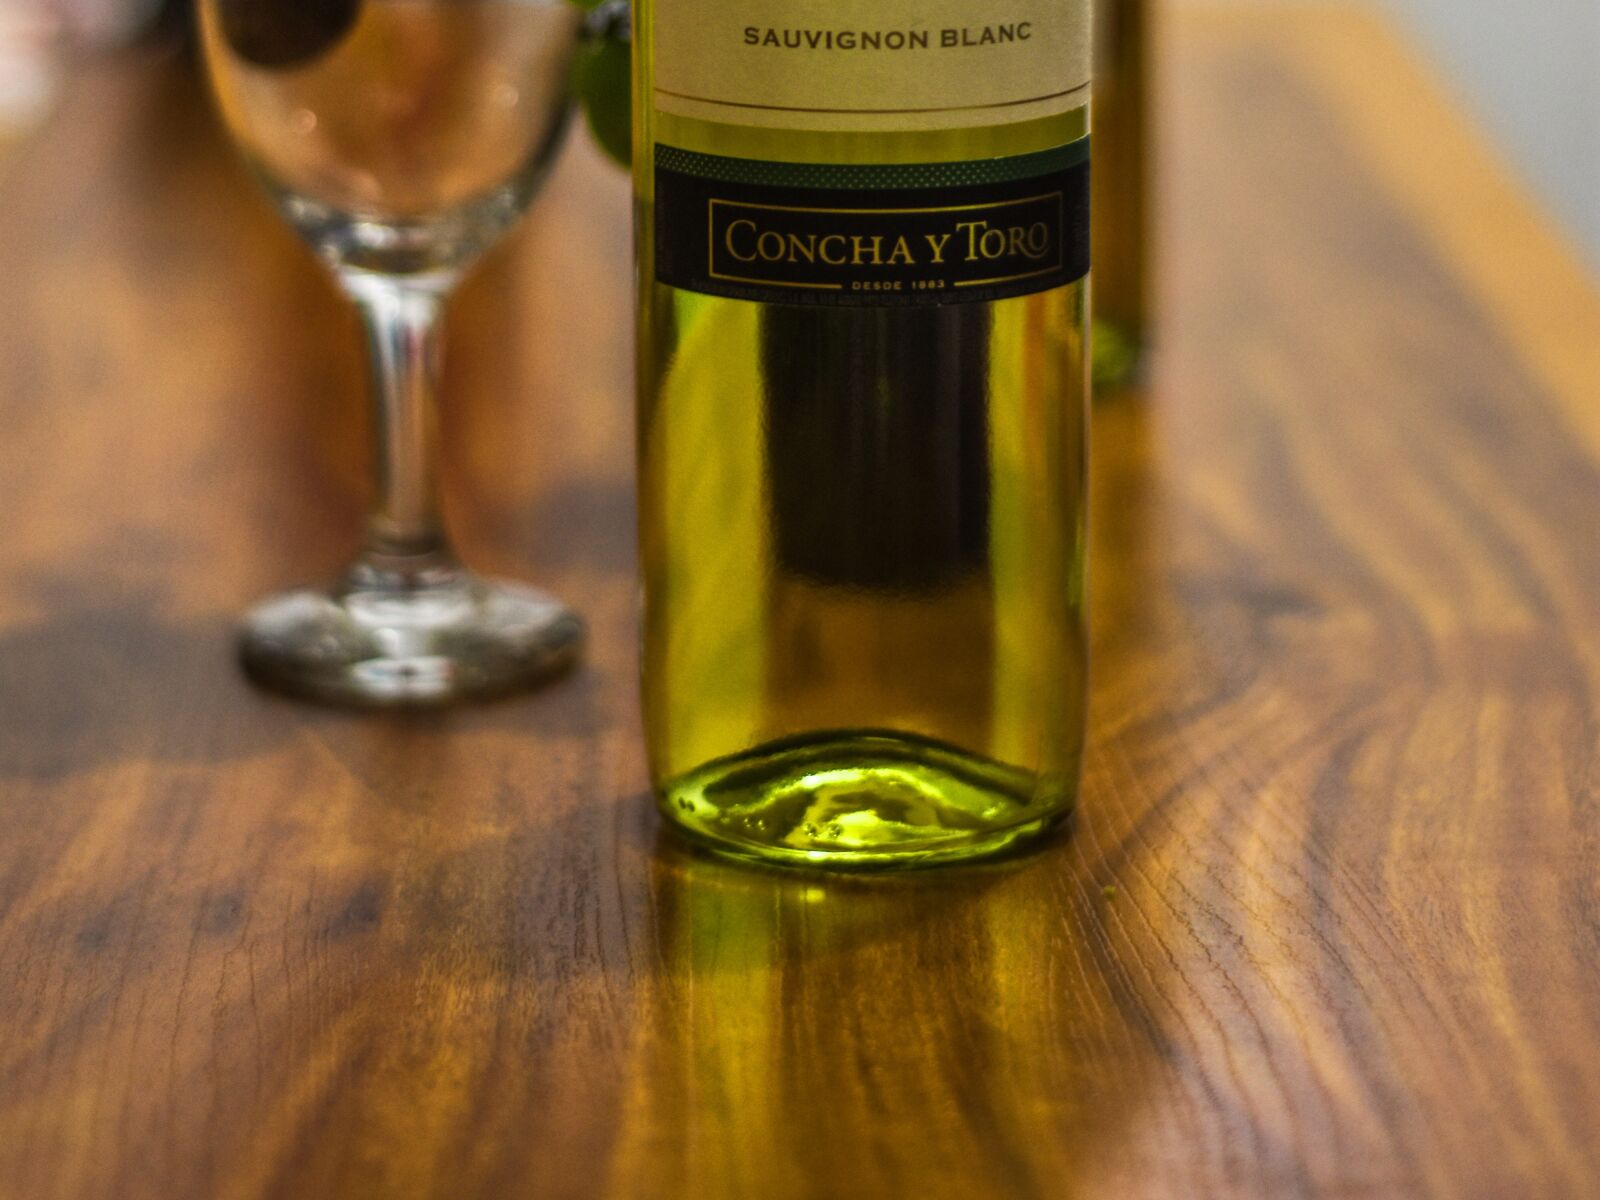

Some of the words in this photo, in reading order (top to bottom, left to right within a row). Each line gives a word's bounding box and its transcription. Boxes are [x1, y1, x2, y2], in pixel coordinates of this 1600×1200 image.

[743, 26, 929, 50] SAUVIGNON
[940, 21, 1033, 48] BLANC
[725, 219, 916, 265] CONCHA
[924, 234, 951, 264] Y
[955, 220, 1048, 260] TORO
[852, 280, 902, 290] DESDE
[911, 279, 945, 290] 1883
